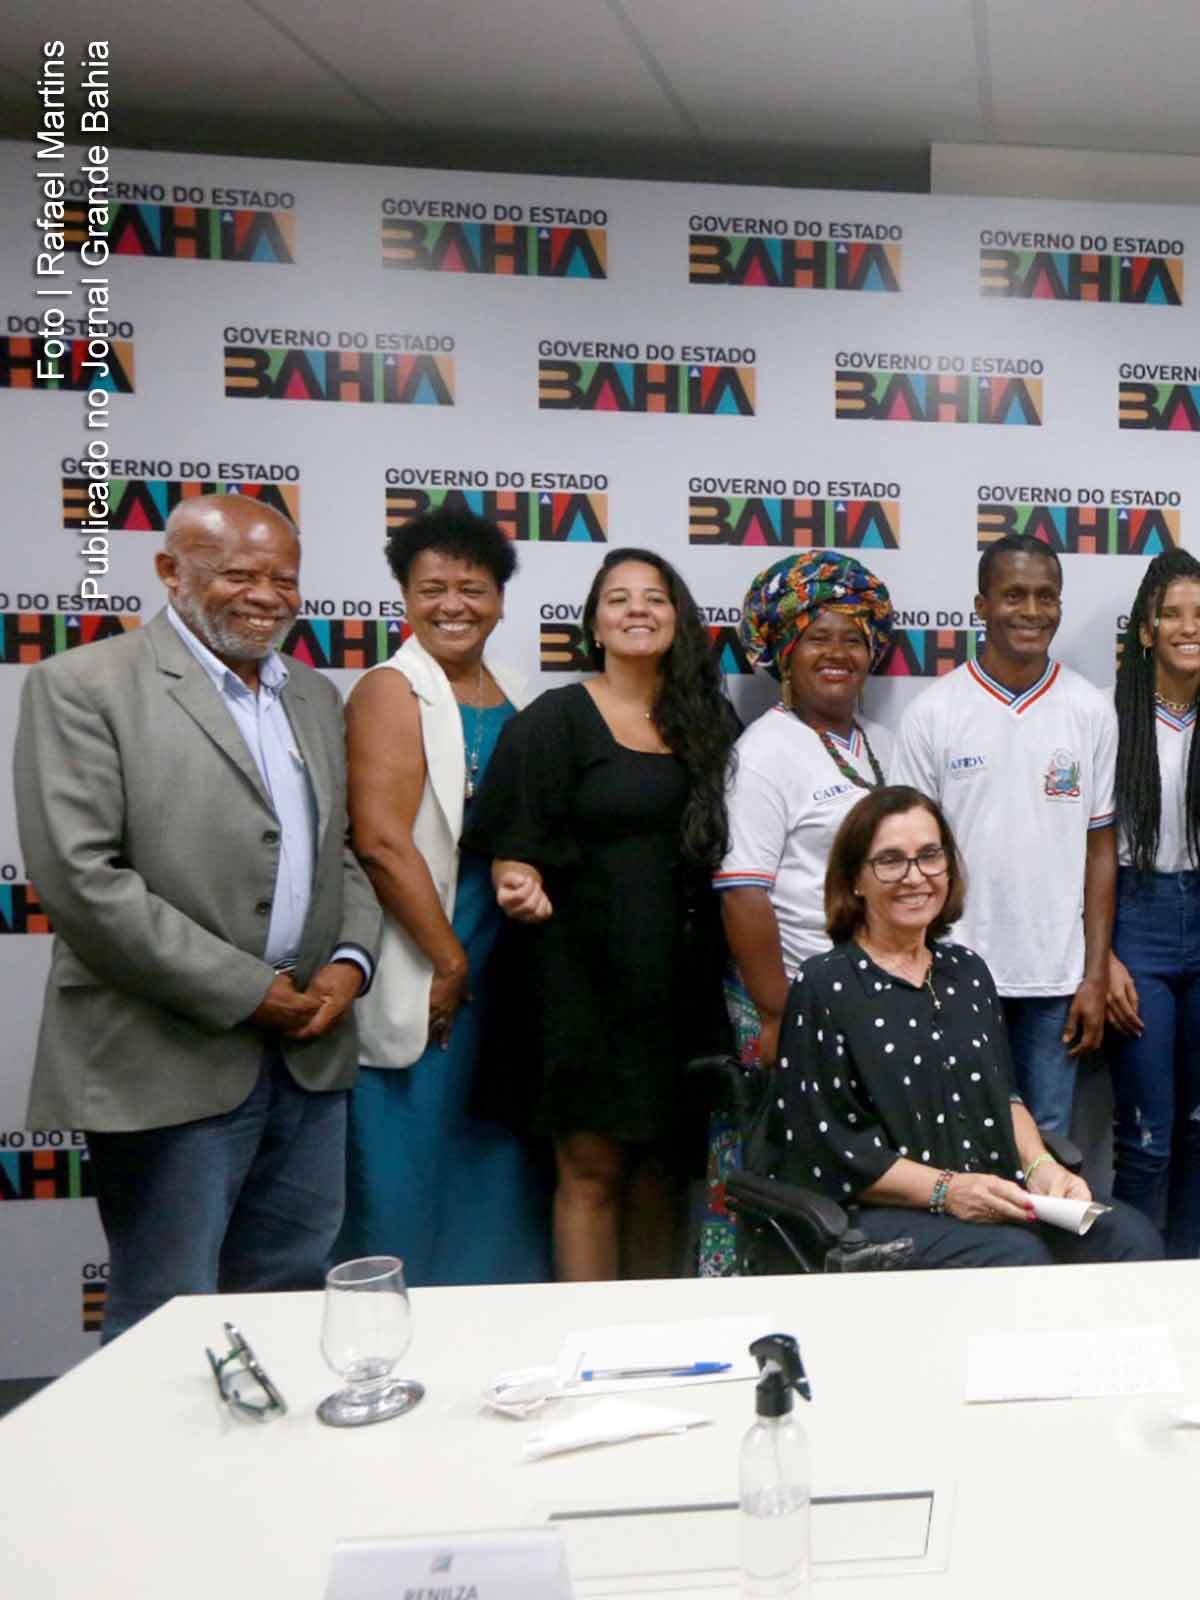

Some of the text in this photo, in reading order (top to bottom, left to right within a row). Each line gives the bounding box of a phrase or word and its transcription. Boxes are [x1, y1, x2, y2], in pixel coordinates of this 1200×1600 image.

[173, 186, 204, 204] DO
[212, 188, 295, 209] ESTADO
[382, 198, 608, 226] GOVERNO DO ESTADO
[689, 215, 903, 241] GOVERNO DO ESTADO
[382, 217, 608, 279] BAHIA
[980, 230, 1184, 255] GOVERNO DO ESTADO
[689, 234, 903, 292] BAHIA
[980, 248, 1184, 306] BAHIA
[7, 316, 39, 333] DO
[224, 326, 456, 353] GOVERNO DO ESTADO
[538, 340, 757, 364] GOVERNO DO ESTADO
[835, 351, 1045, 375] GOVERNO DO ESTADO
[224, 345, 456, 406] BAHIA
[538, 358, 757, 416] BAHIA
[835, 372, 1045, 426] BAHIA
[61, 457, 300, 481] GERNO DO ESTADO
[385, 468, 608, 490] GOVERNO DO ESTADO
[689, 477, 901, 498] GOVERNO DO ESTADO
[977, 485, 1182, 506] GOVERNO DO ESTADO
[689, 495, 901, 550] BAHIA
[977, 503, 1181, 556] BAHIA
[17, 594, 49, 610] DO
[57, 595, 142, 612] ESTADO
[343, 600, 372, 616] DO
[936, 611, 963, 627] DO
[32, 1131, 63, 1147] DO
